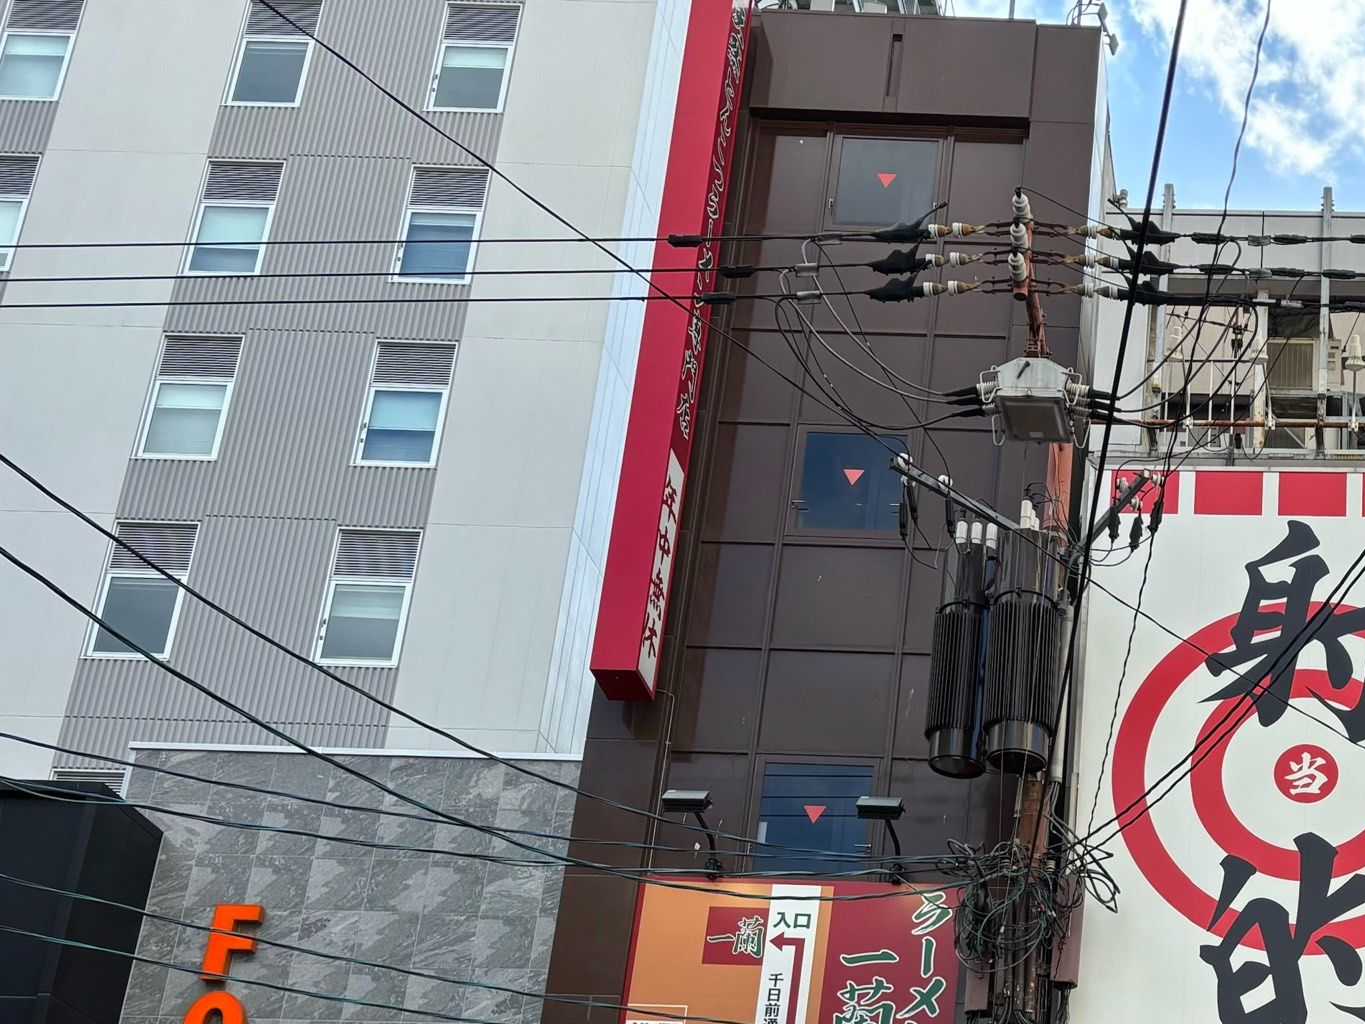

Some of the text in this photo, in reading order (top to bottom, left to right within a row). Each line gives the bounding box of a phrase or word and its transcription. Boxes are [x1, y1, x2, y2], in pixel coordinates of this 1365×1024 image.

[642, 474, 680, 660] 年中無休
[1284, 752, 1329, 796] 当
[773, 911, 812, 930] 入口
